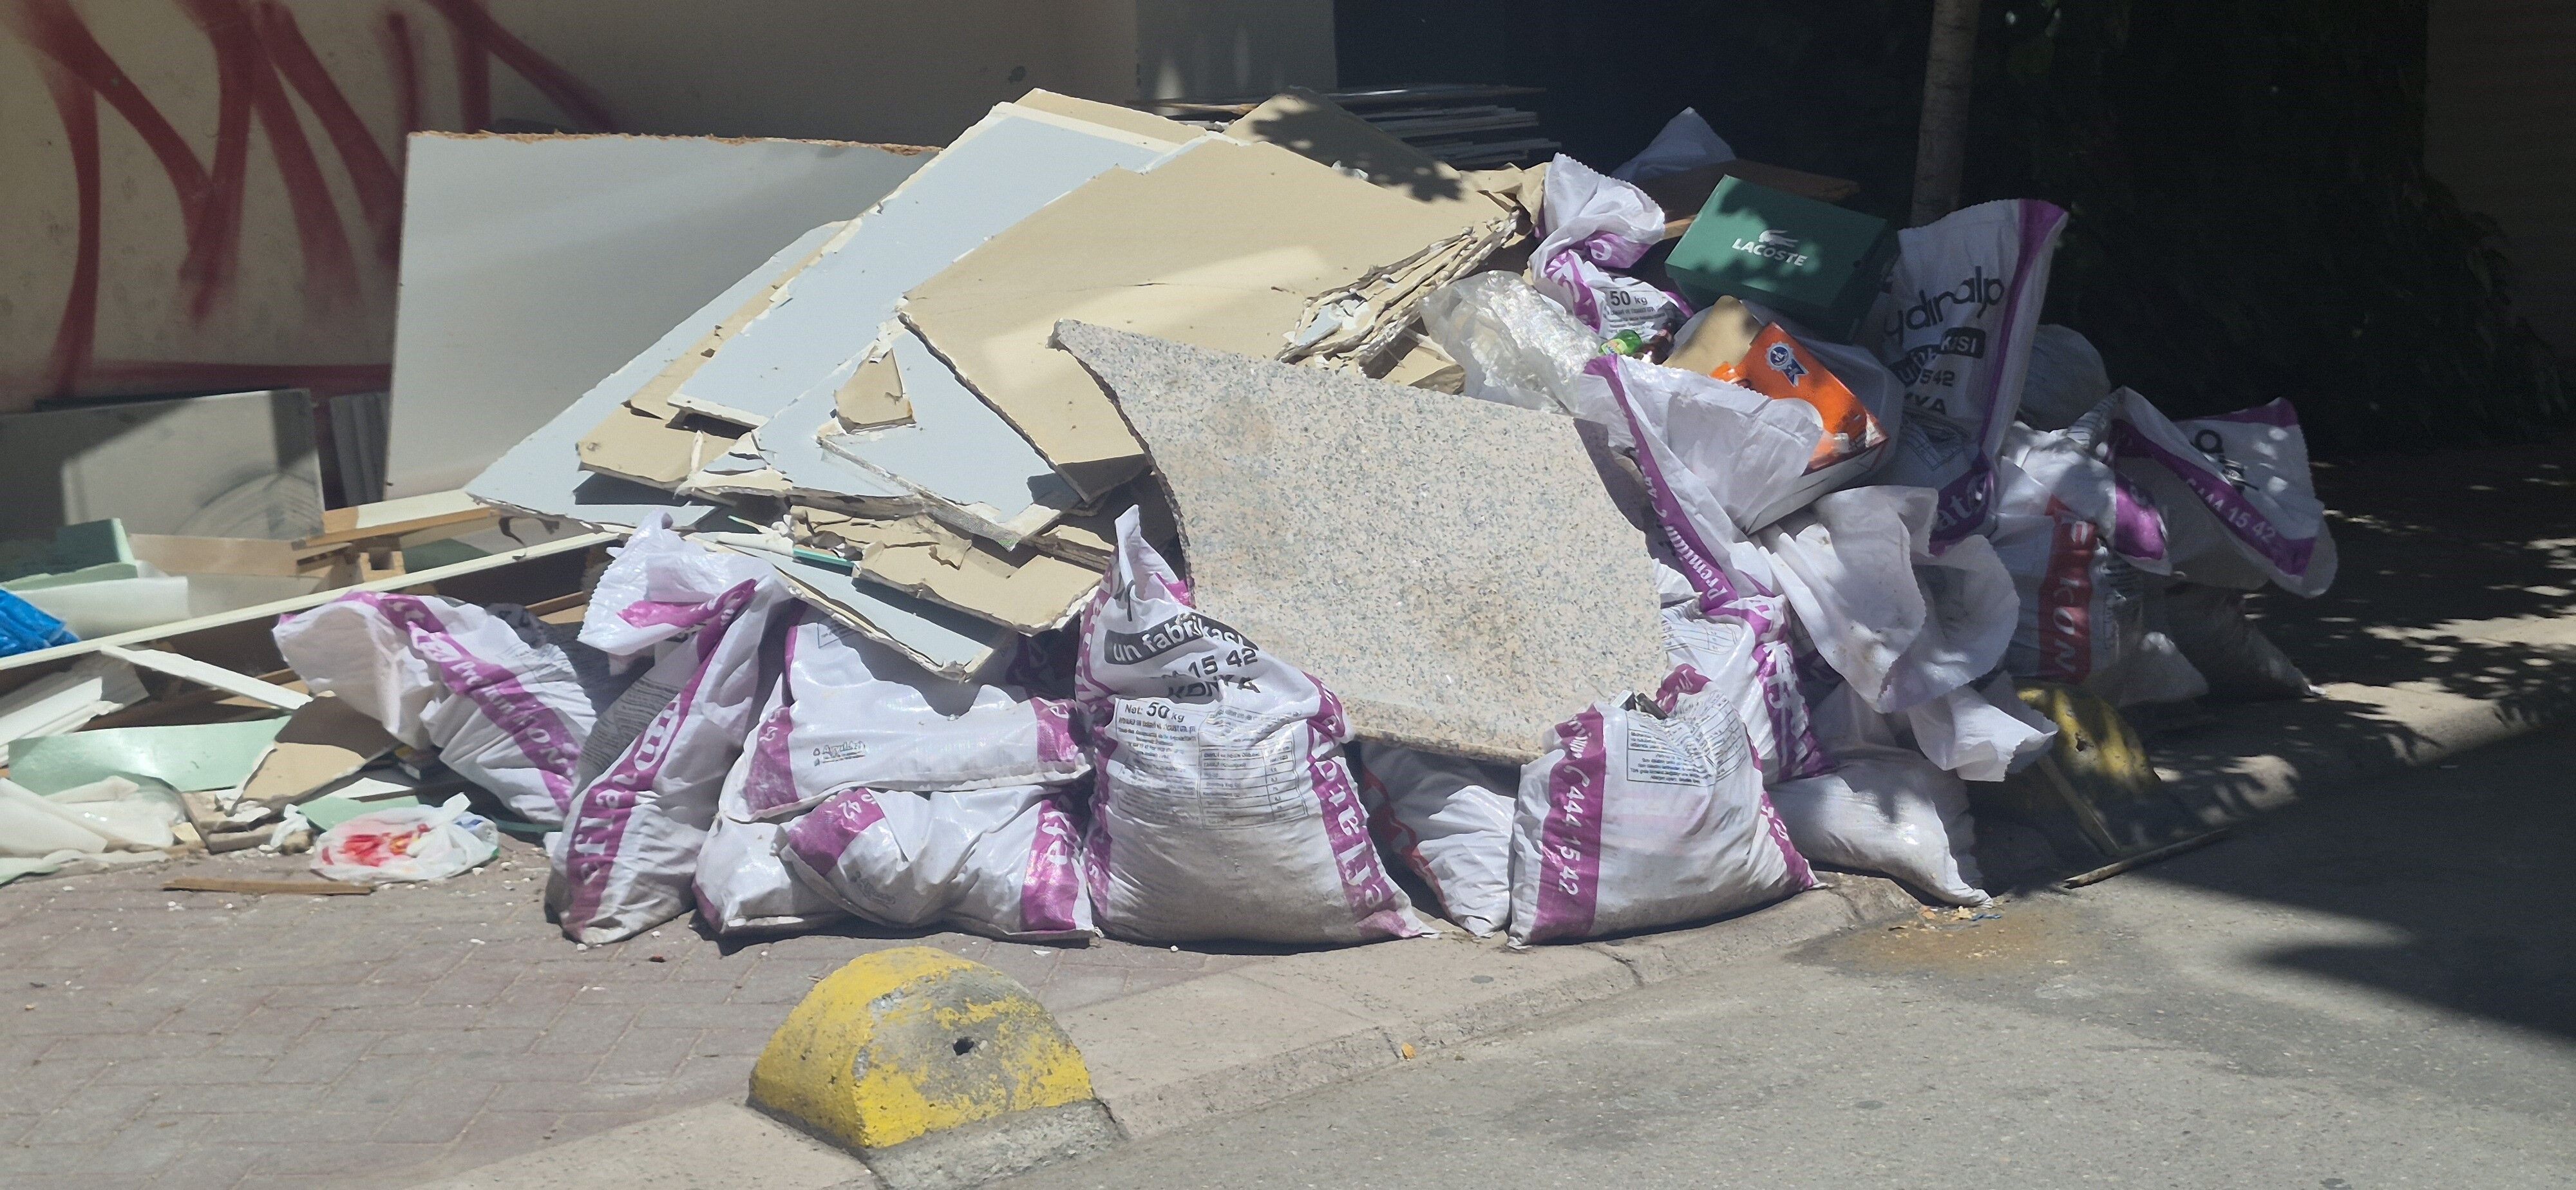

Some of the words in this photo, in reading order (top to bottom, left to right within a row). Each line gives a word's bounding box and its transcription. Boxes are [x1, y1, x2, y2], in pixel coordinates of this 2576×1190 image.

[1732, 238, 1808, 266] LACOSTE
[1610, 290, 1631, 306] 50
[1634, 297, 1648, 305] kg
[1113, 643, 1142, 661] un
[1188, 655, 1218, 679] 15
[1226, 647, 1259, 668] 42
[1146, 702, 1171, 719] 50
[1171, 713, 1185, 722] kg
[1563, 786, 1586, 827] 444
[1558, 836, 1582, 862] 15
[1558, 865, 1580, 895] 42
